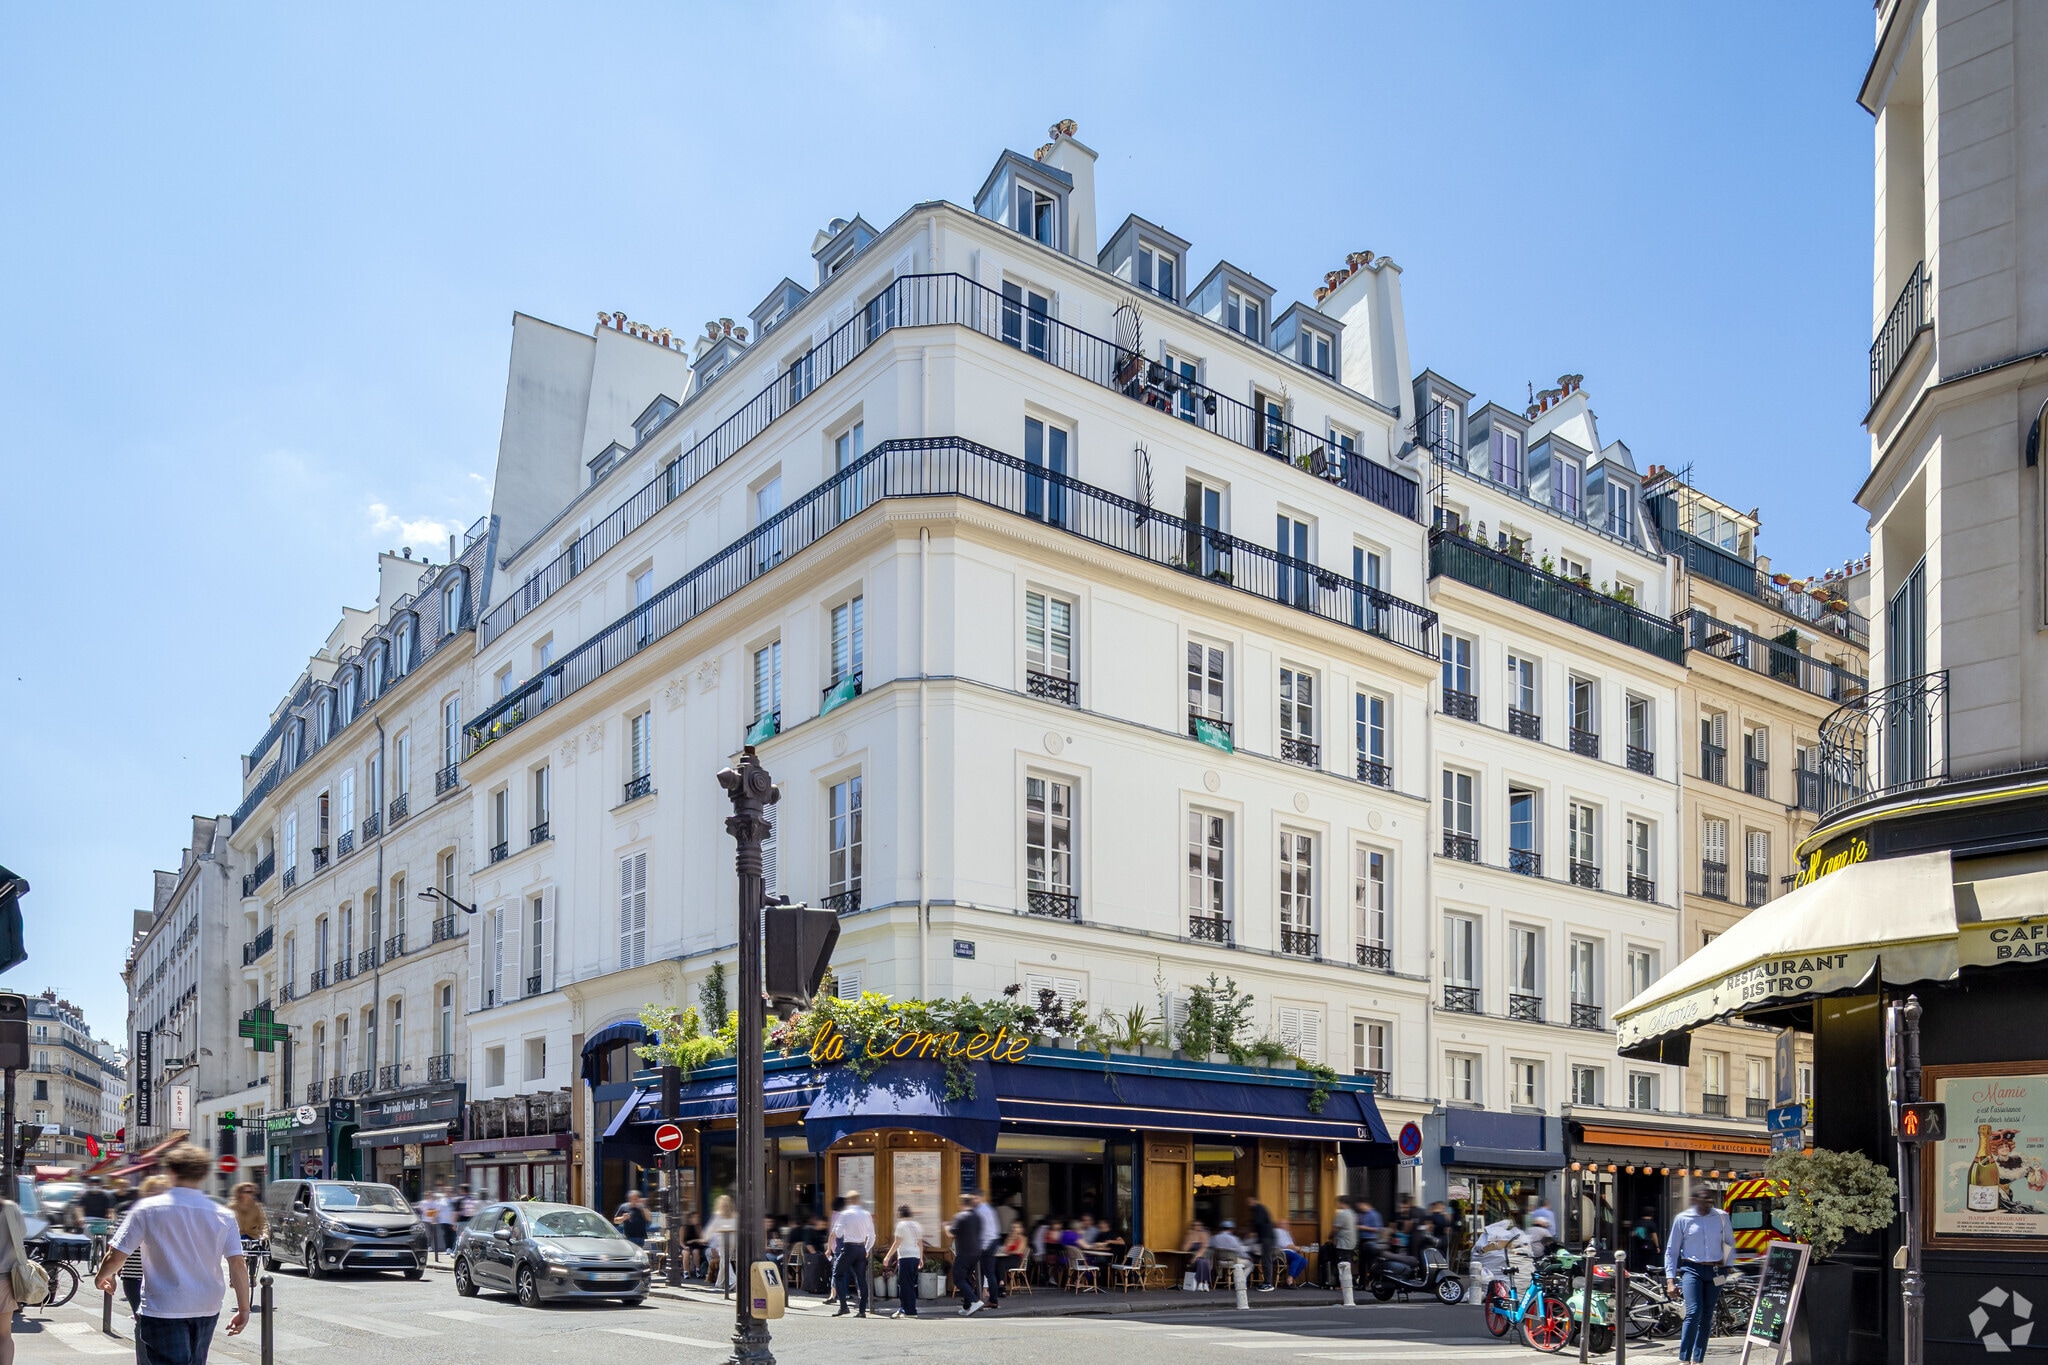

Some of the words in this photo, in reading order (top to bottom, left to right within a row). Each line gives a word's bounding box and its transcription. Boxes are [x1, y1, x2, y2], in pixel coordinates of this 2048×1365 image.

[1794, 837, 1868, 890] Mamie
[1990, 925, 2048, 943] CAF
[1997, 941, 2048, 959] BAR
[1726, 953, 1848, 991] RESTAURANT
[1742, 976, 1812, 1000] BISTRO
[1649, 1000, 1698, 1032] Mamie
[810, 1019, 845, 1061] la
[866, 1017, 1030, 1062] Comète
[1780, 1048, 1788, 1092] P
[141, 1081, 147, 1090] du
[1972, 1082, 2027, 1106] Mamie
[383, 1101, 401, 1114] Ravioli
[402, 1099, 415, 1111] Nord
[420, 1098, 428, 1109] Est
[1712, 1144, 1747, 1153] MENKICCHI
